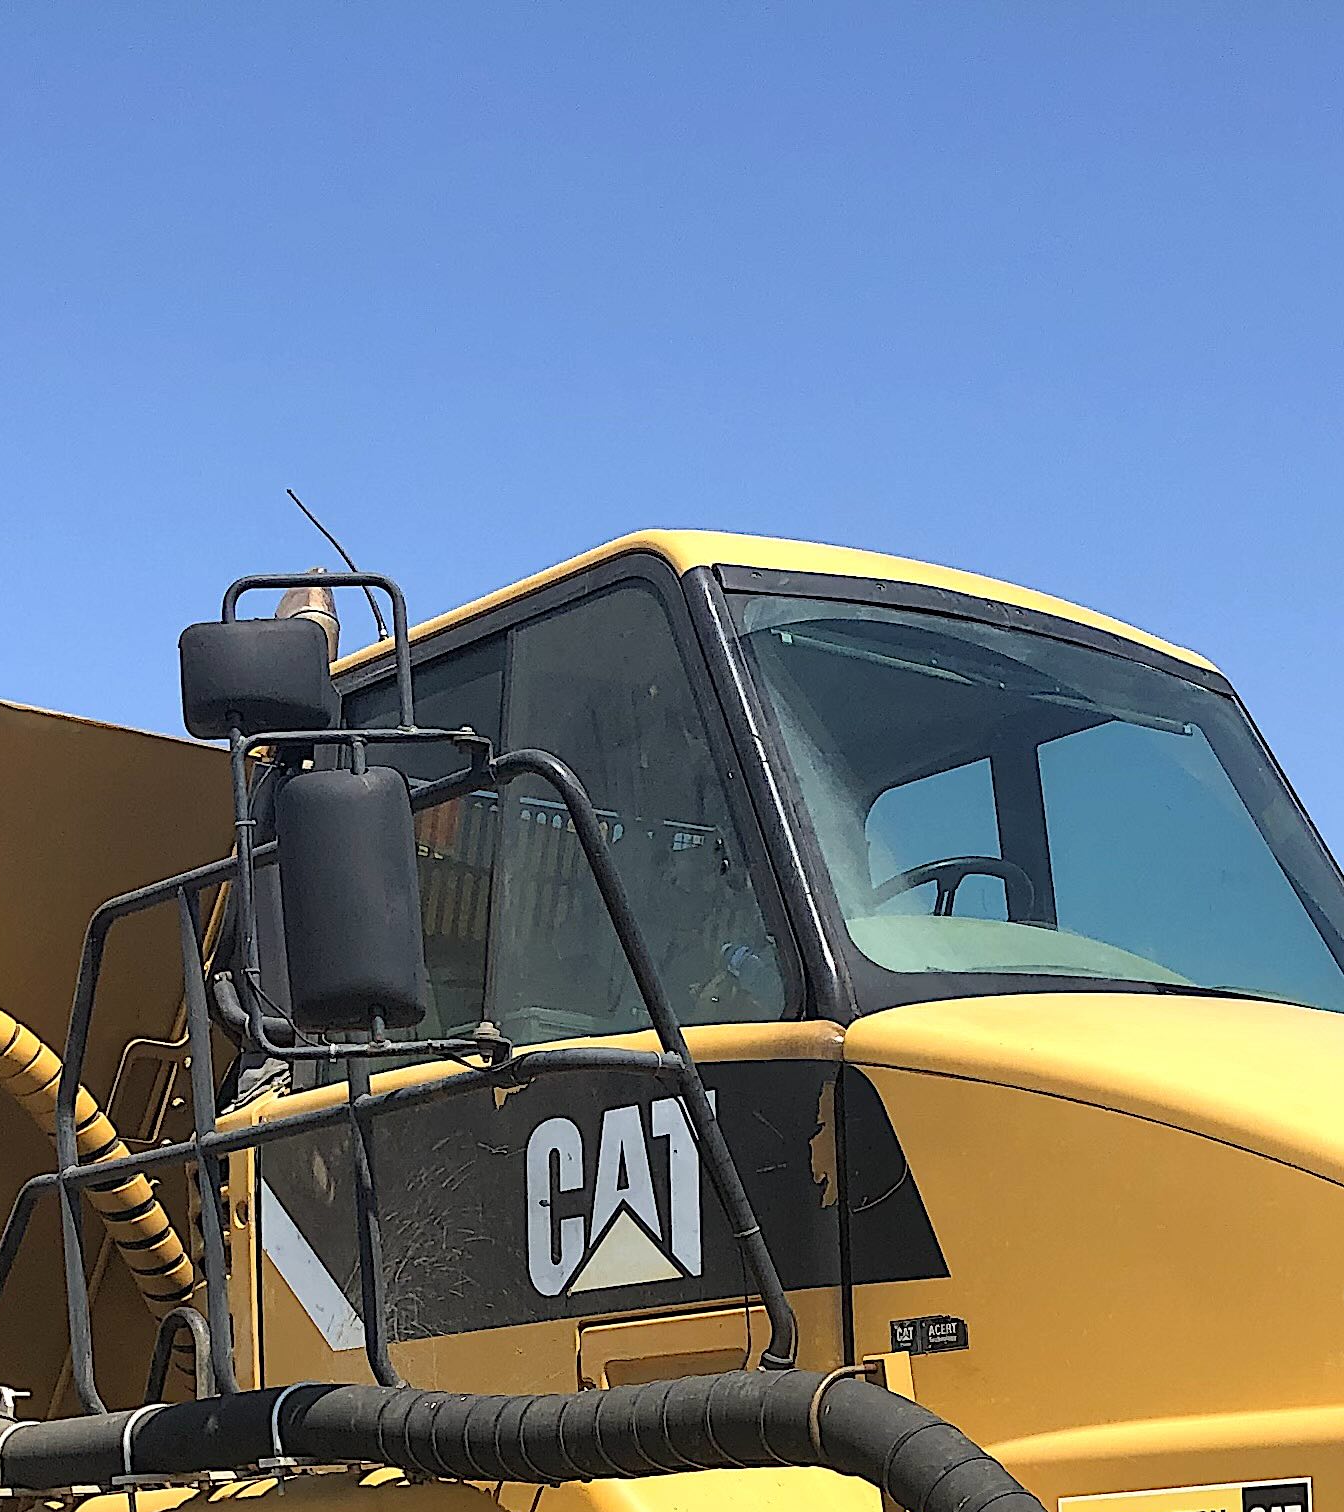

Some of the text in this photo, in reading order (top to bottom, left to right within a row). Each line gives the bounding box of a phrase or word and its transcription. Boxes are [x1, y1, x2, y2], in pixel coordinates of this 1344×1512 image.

[526, 1089, 716, 1297] CAT
[897, 1326, 914, 1342] CAT
[928, 1322, 958, 1336] ACERT
